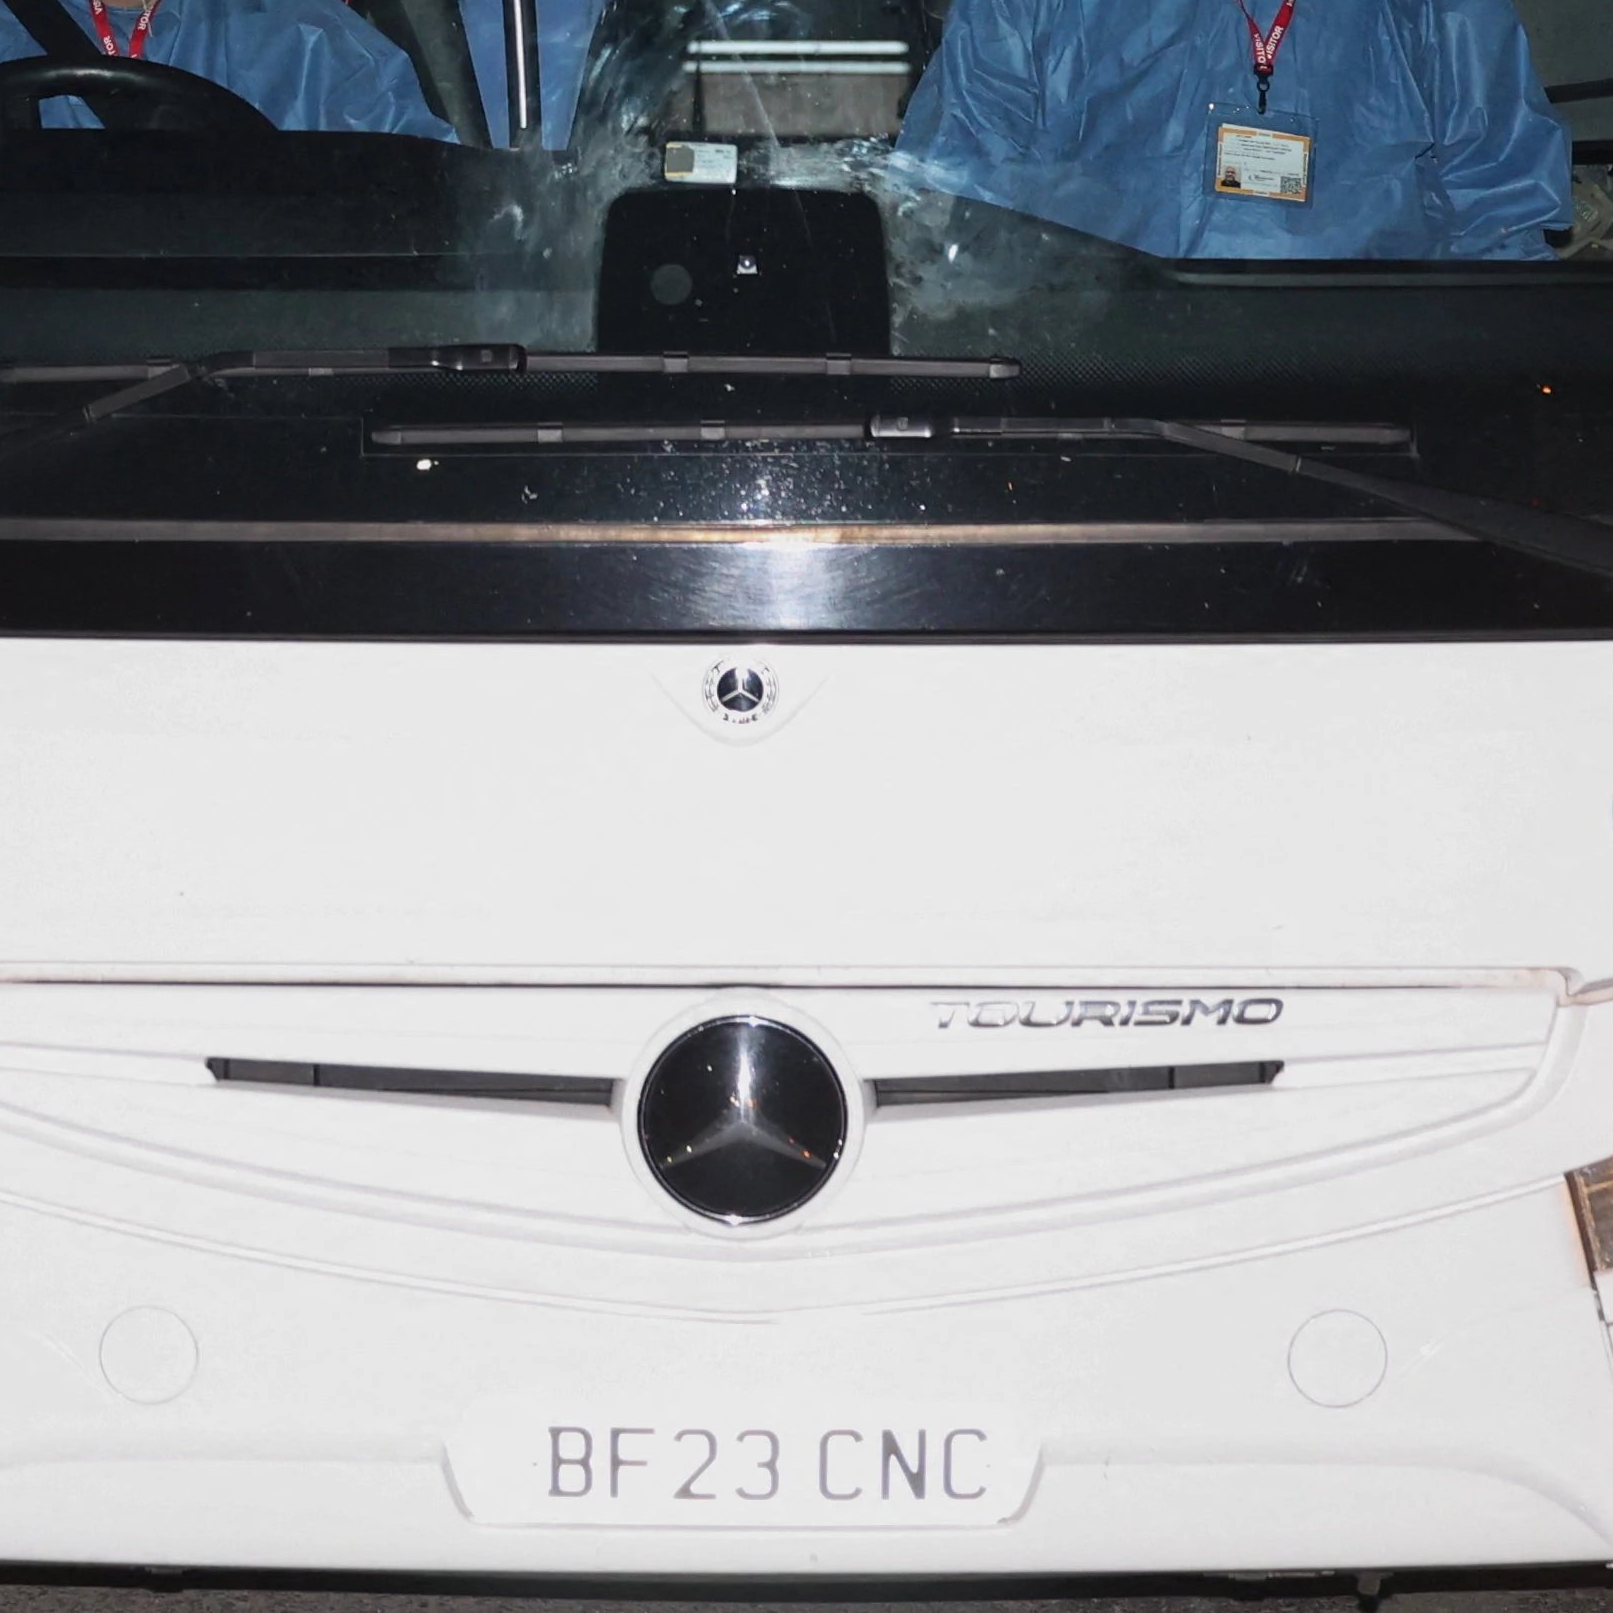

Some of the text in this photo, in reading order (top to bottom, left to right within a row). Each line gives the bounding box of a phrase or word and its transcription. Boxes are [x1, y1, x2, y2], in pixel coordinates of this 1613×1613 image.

[929, 997, 1285, 1029] TOURISMO
[547, 1425, 988, 1501] BF23 CNC
